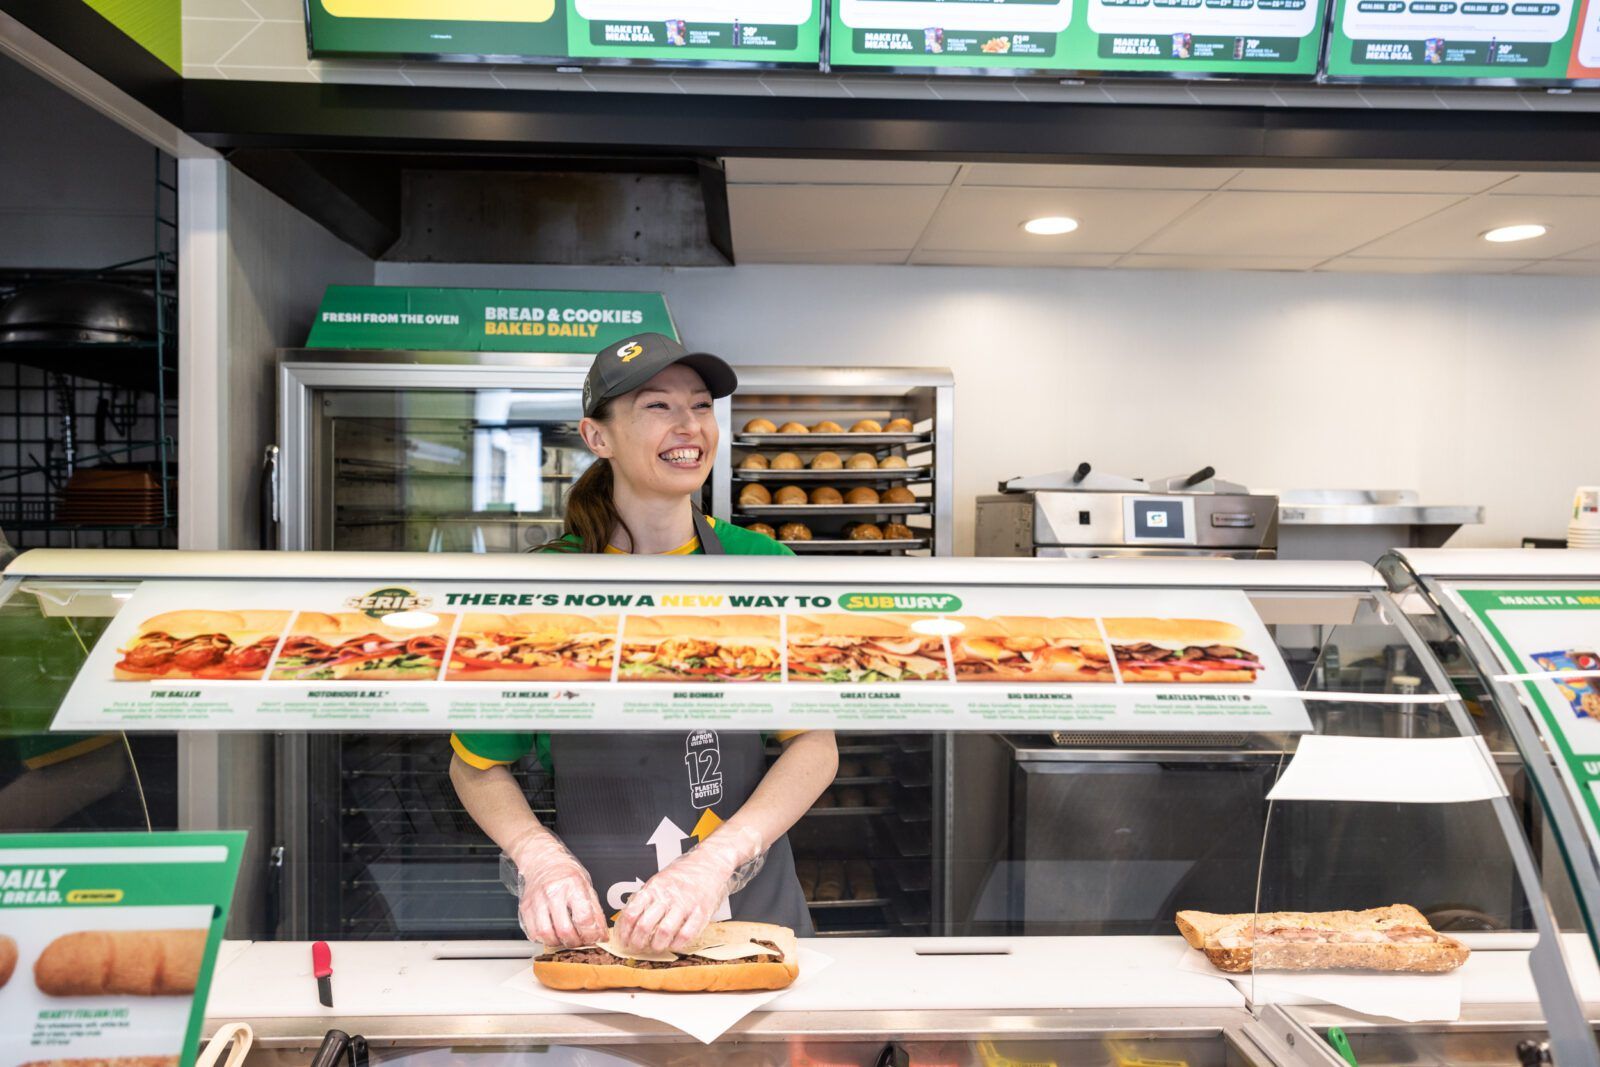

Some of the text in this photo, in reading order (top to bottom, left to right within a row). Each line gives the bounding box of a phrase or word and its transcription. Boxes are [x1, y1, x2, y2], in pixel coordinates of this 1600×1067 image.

[605, 25, 650, 34] MAKE IT A
[605, 33, 655, 42] MEAL DEAL
[864, 33, 908, 42] MAKE IT A
[1114, 38, 1157, 47] MAKE IT A
[864, 40, 913, 50] MEAL DEAL
[1112, 46, 1160, 54] MEAL DEAL
[1367, 44, 1392, 52] MAKE
[1392, 44, 1401, 52] IT
[1366, 51, 1413, 60] MEAL DEAL
[322, 312, 460, 325] FRESH FROM THE OVEN
[484, 306, 643, 324] BREAD & COOKIES
[484, 322, 598, 337] BAKED DAILY
[349, 596, 432, 610] SERIES
[446, 593, 954, 610] THERE'S NOW A NEW WAY TO SUBWAY
[1498, 596, 1548, 604] MAKE
[1546, 596, 1564, 604] IT
[1565, 596, 1580, 604] A
[692, 732, 713, 742] APRON
[685, 748, 722, 786] 12
[694, 782, 719, 792] PLASTIC
[694, 788, 720, 798] BOTTLES
[2, 890, 62, 904] BREAD.
[38, 1008, 74, 1019] HEARTY
